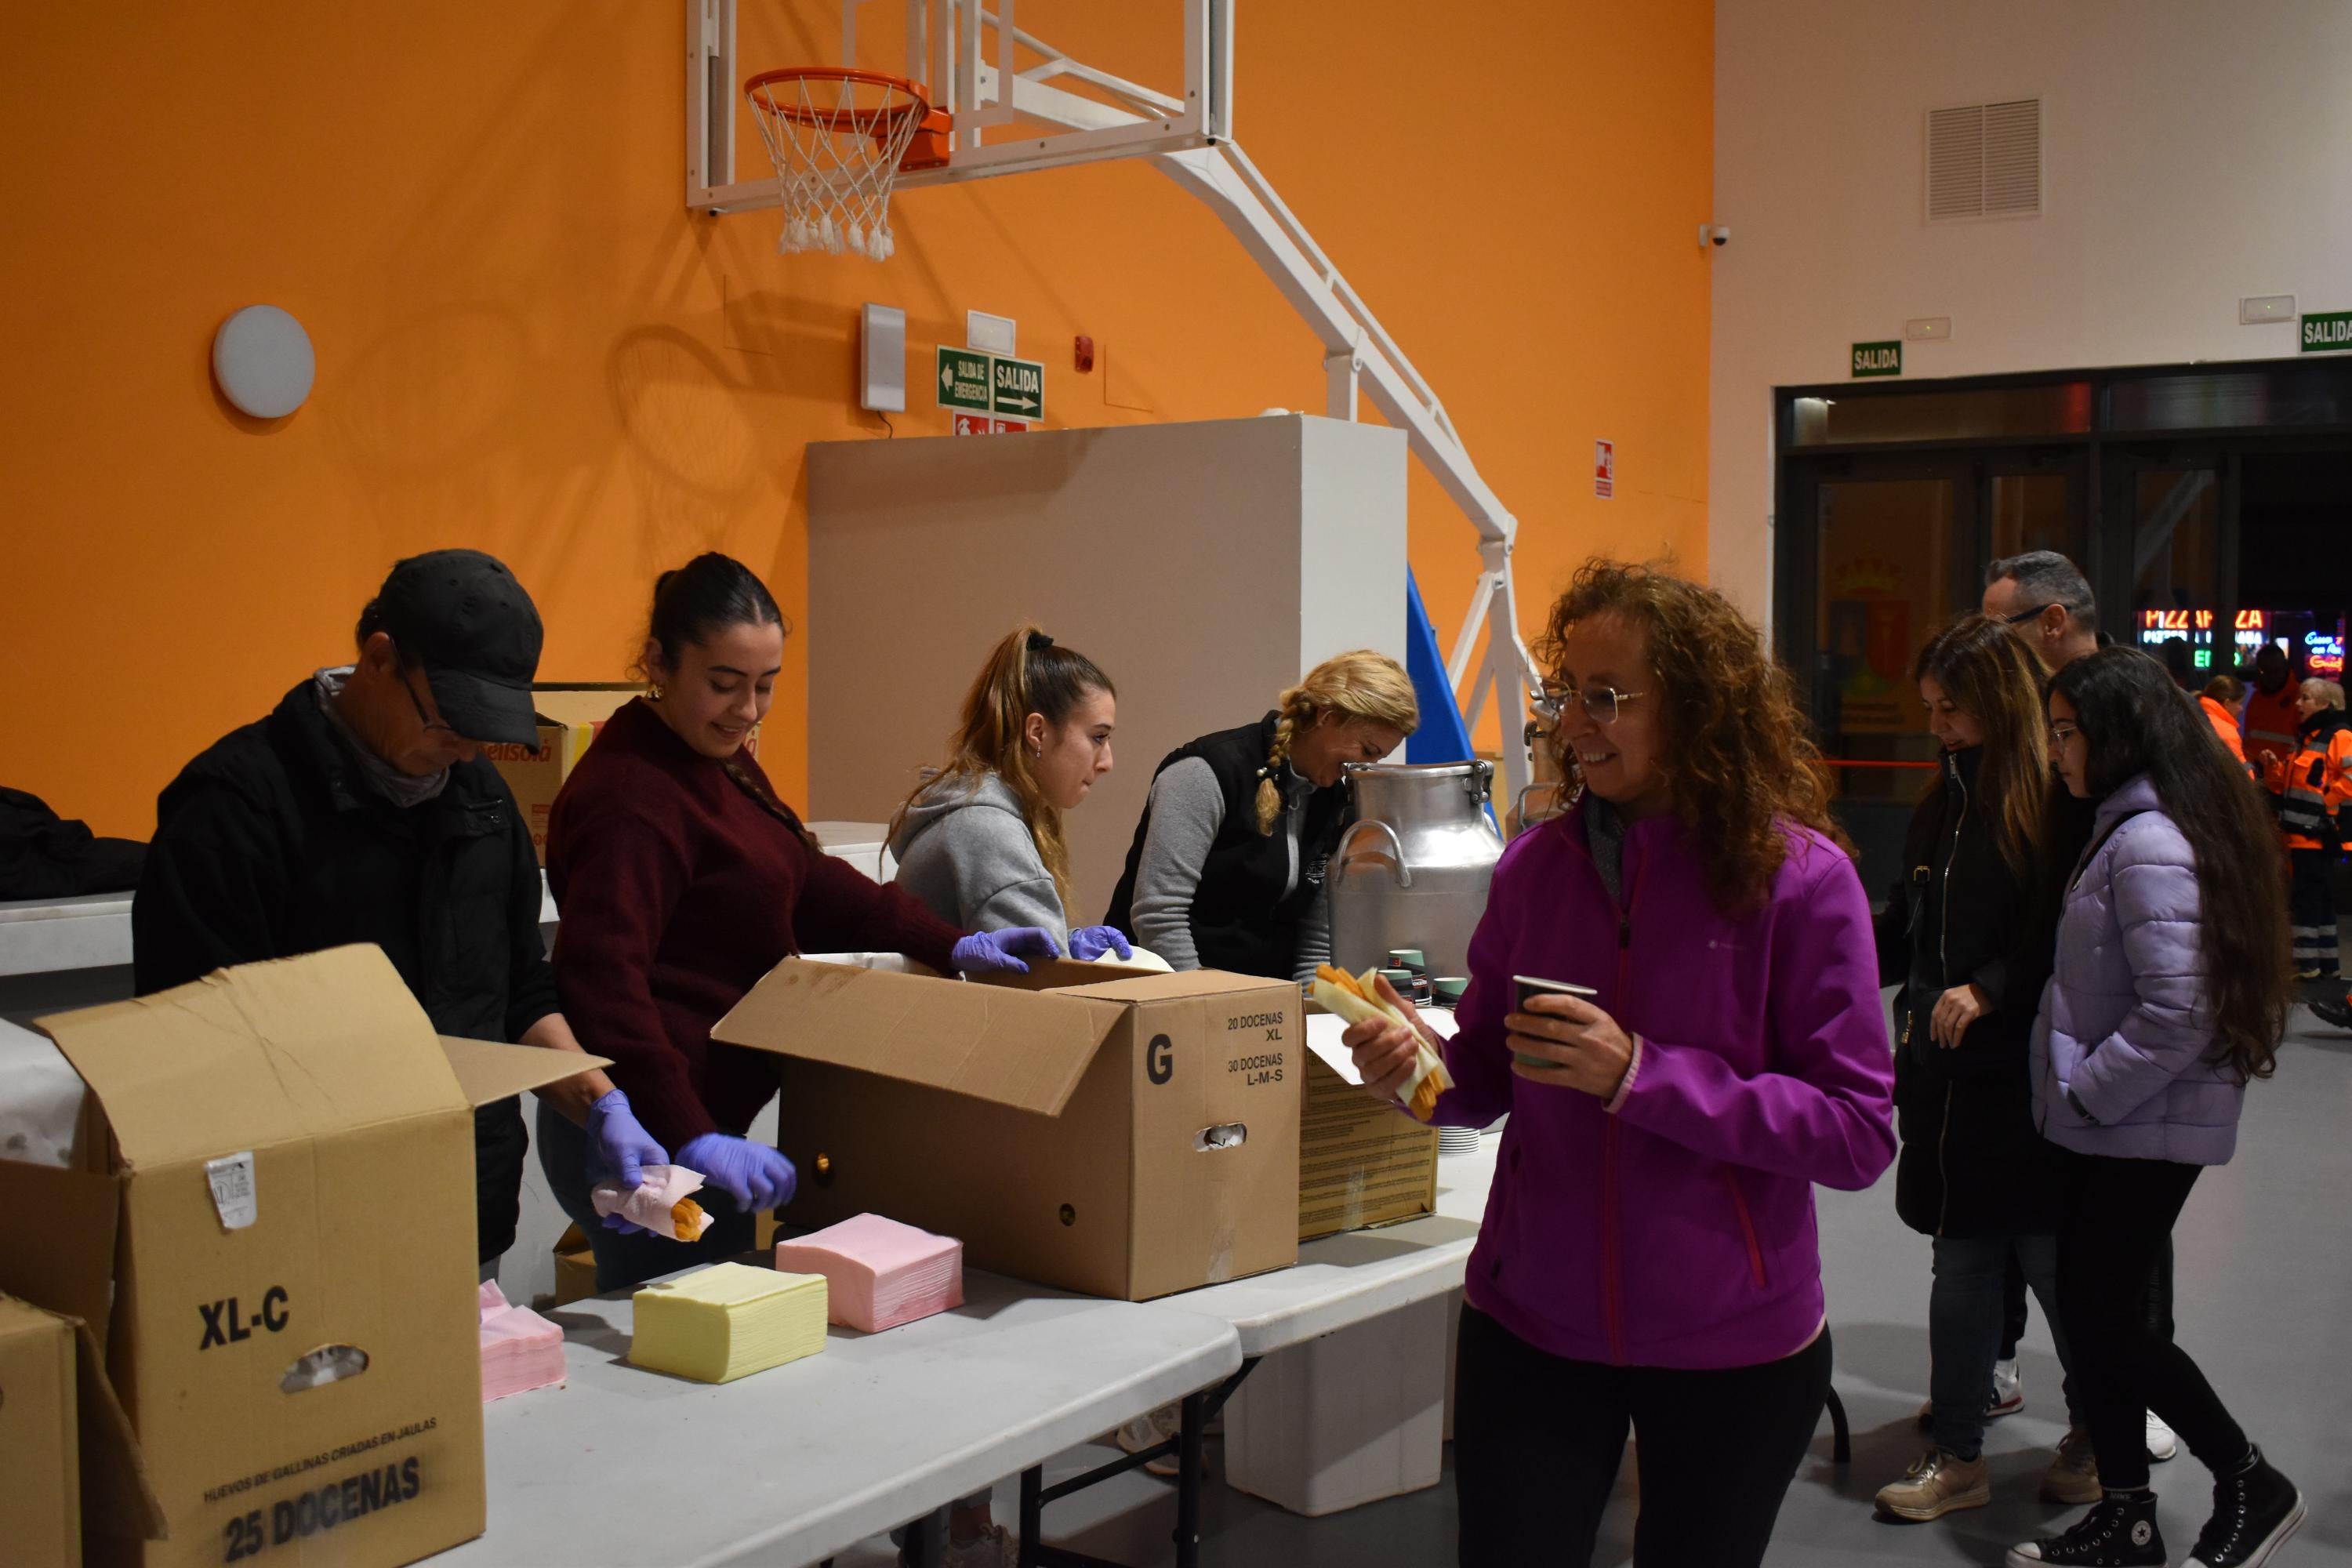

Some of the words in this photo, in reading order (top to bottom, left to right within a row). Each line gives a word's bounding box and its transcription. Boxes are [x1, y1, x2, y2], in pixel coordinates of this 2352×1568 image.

[2305, 320, 2352, 343] SALIDA
[1855, 348, 1898, 370] SALIDA
[958, 361, 977, 379] SALIDA
[977, 363, 985, 380] DE
[996, 365, 1040, 394] SALIDA
[954, 381, 988, 401] EMERGENCIA
[1228, 1017, 1239, 1030] 20
[1240, 1011, 1283, 1029] DOCENAS
[1266, 1028, 1283, 1041] XL
[1147, 1033, 1173, 1085] G
[1228, 1059, 1239, 1073] 30
[1240, 1053, 1283, 1070] DOCENAS
[1247, 1069, 1283, 1086] L-M-S
[198, 1285, 289, 1351] XL-C
[204, 1477, 252, 1503] HUEVOS
[254, 1471, 270, 1486] DE
[273, 1452, 329, 1480] GALLINAS
[331, 1436, 379, 1461] CRIADAS
[380, 1430, 396, 1445] EN
[396, 1417, 437, 1439] JAULAS
[225, 1509, 264, 1563] 25
[271, 1457, 420, 1546] DOCENAS
